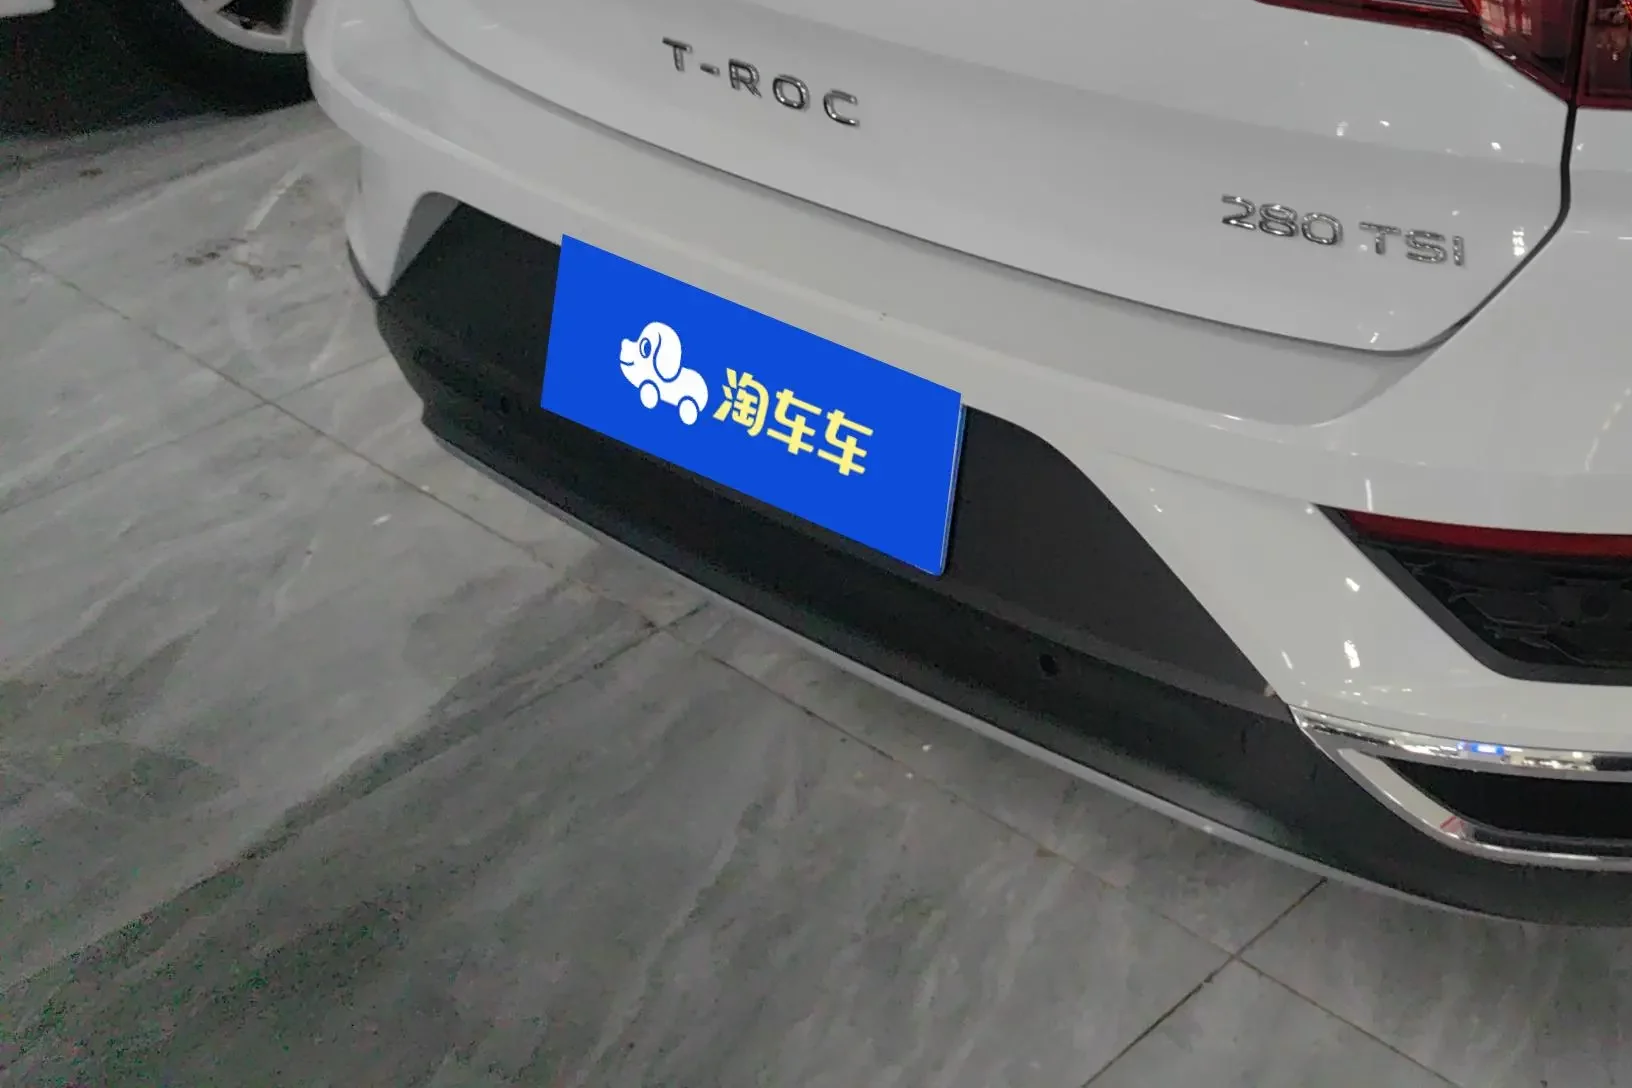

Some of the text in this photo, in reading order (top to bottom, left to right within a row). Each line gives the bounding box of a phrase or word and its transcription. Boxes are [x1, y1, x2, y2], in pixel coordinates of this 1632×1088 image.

[662, 36, 860, 127] T-ROC
[1221, 194, 1466, 267] 280 TSI
